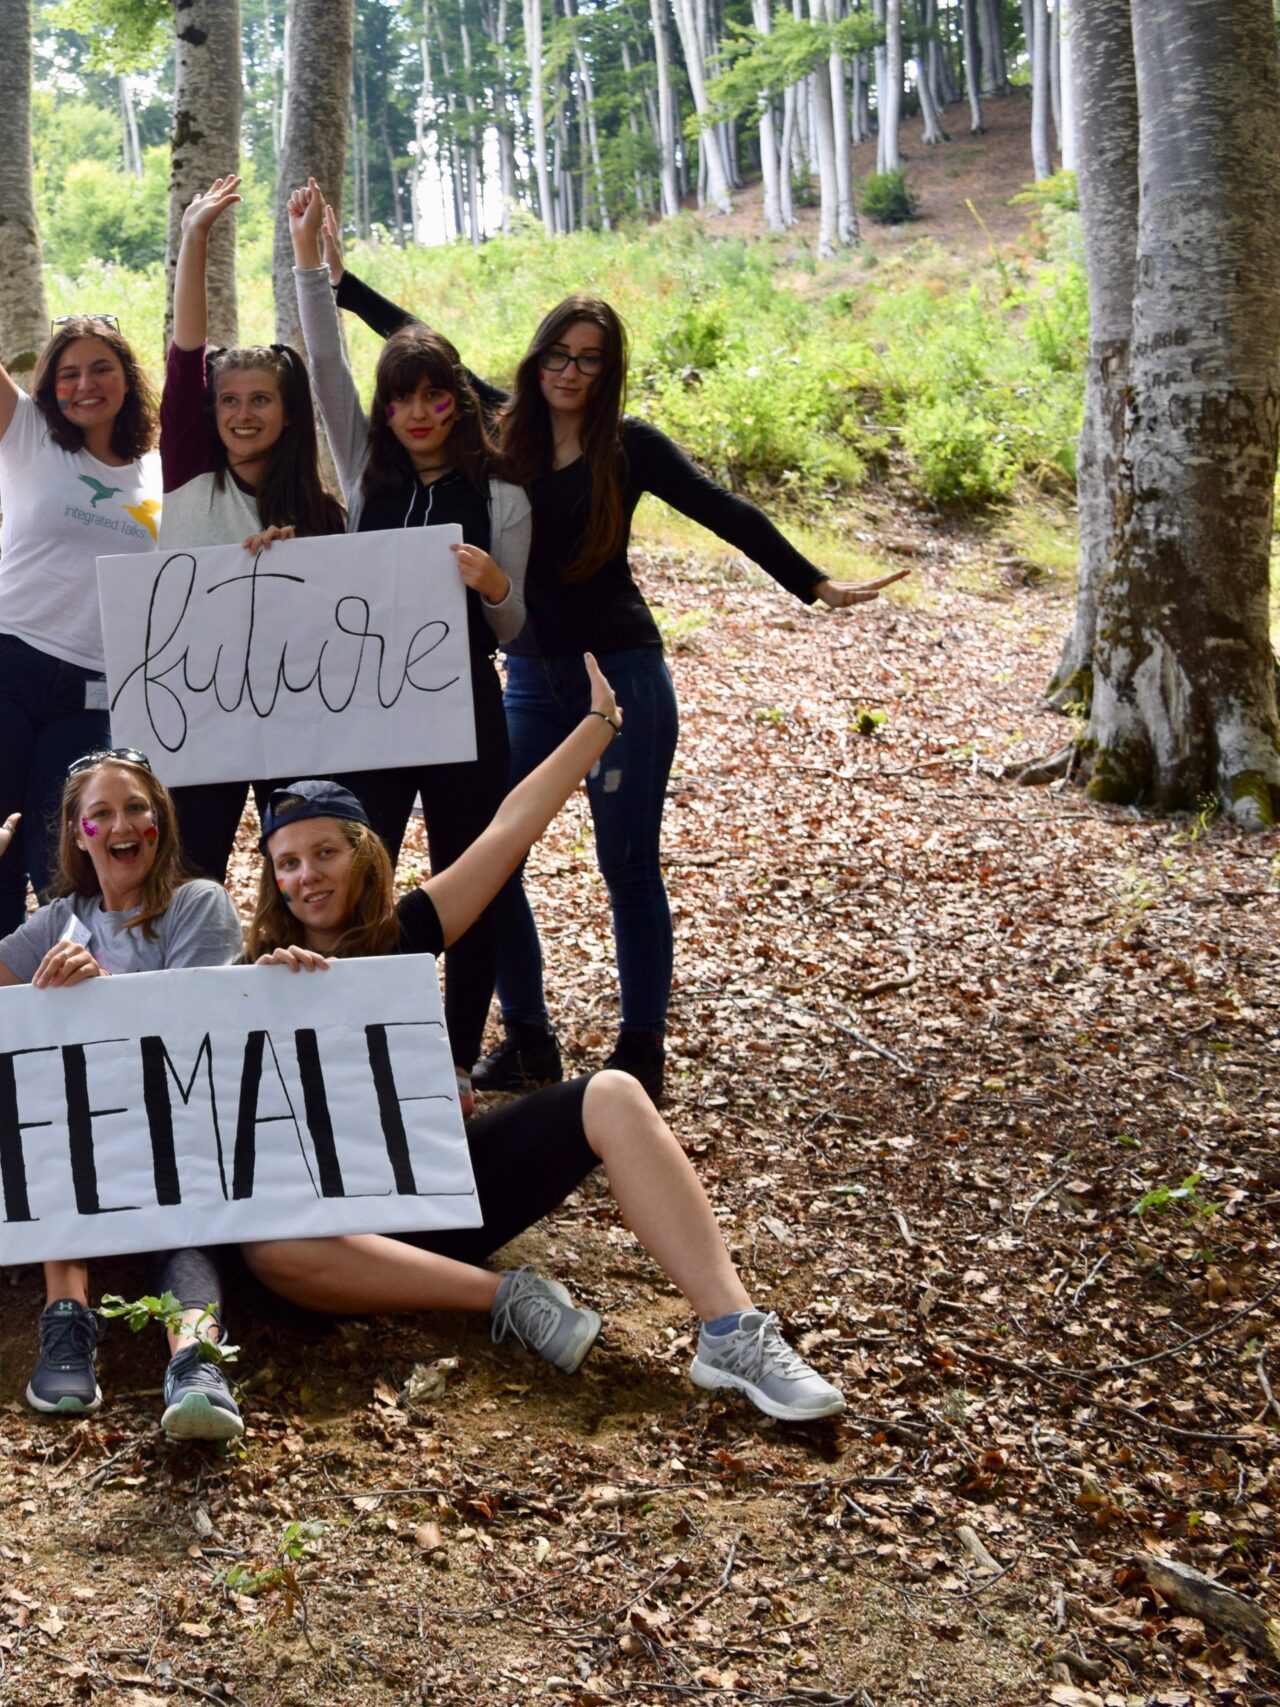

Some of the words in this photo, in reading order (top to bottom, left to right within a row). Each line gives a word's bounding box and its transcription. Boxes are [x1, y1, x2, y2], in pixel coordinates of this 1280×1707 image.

[63, 504, 120, 530] Integrated
[120, 520, 146, 539] Talks
[110, 550, 460, 752] future
